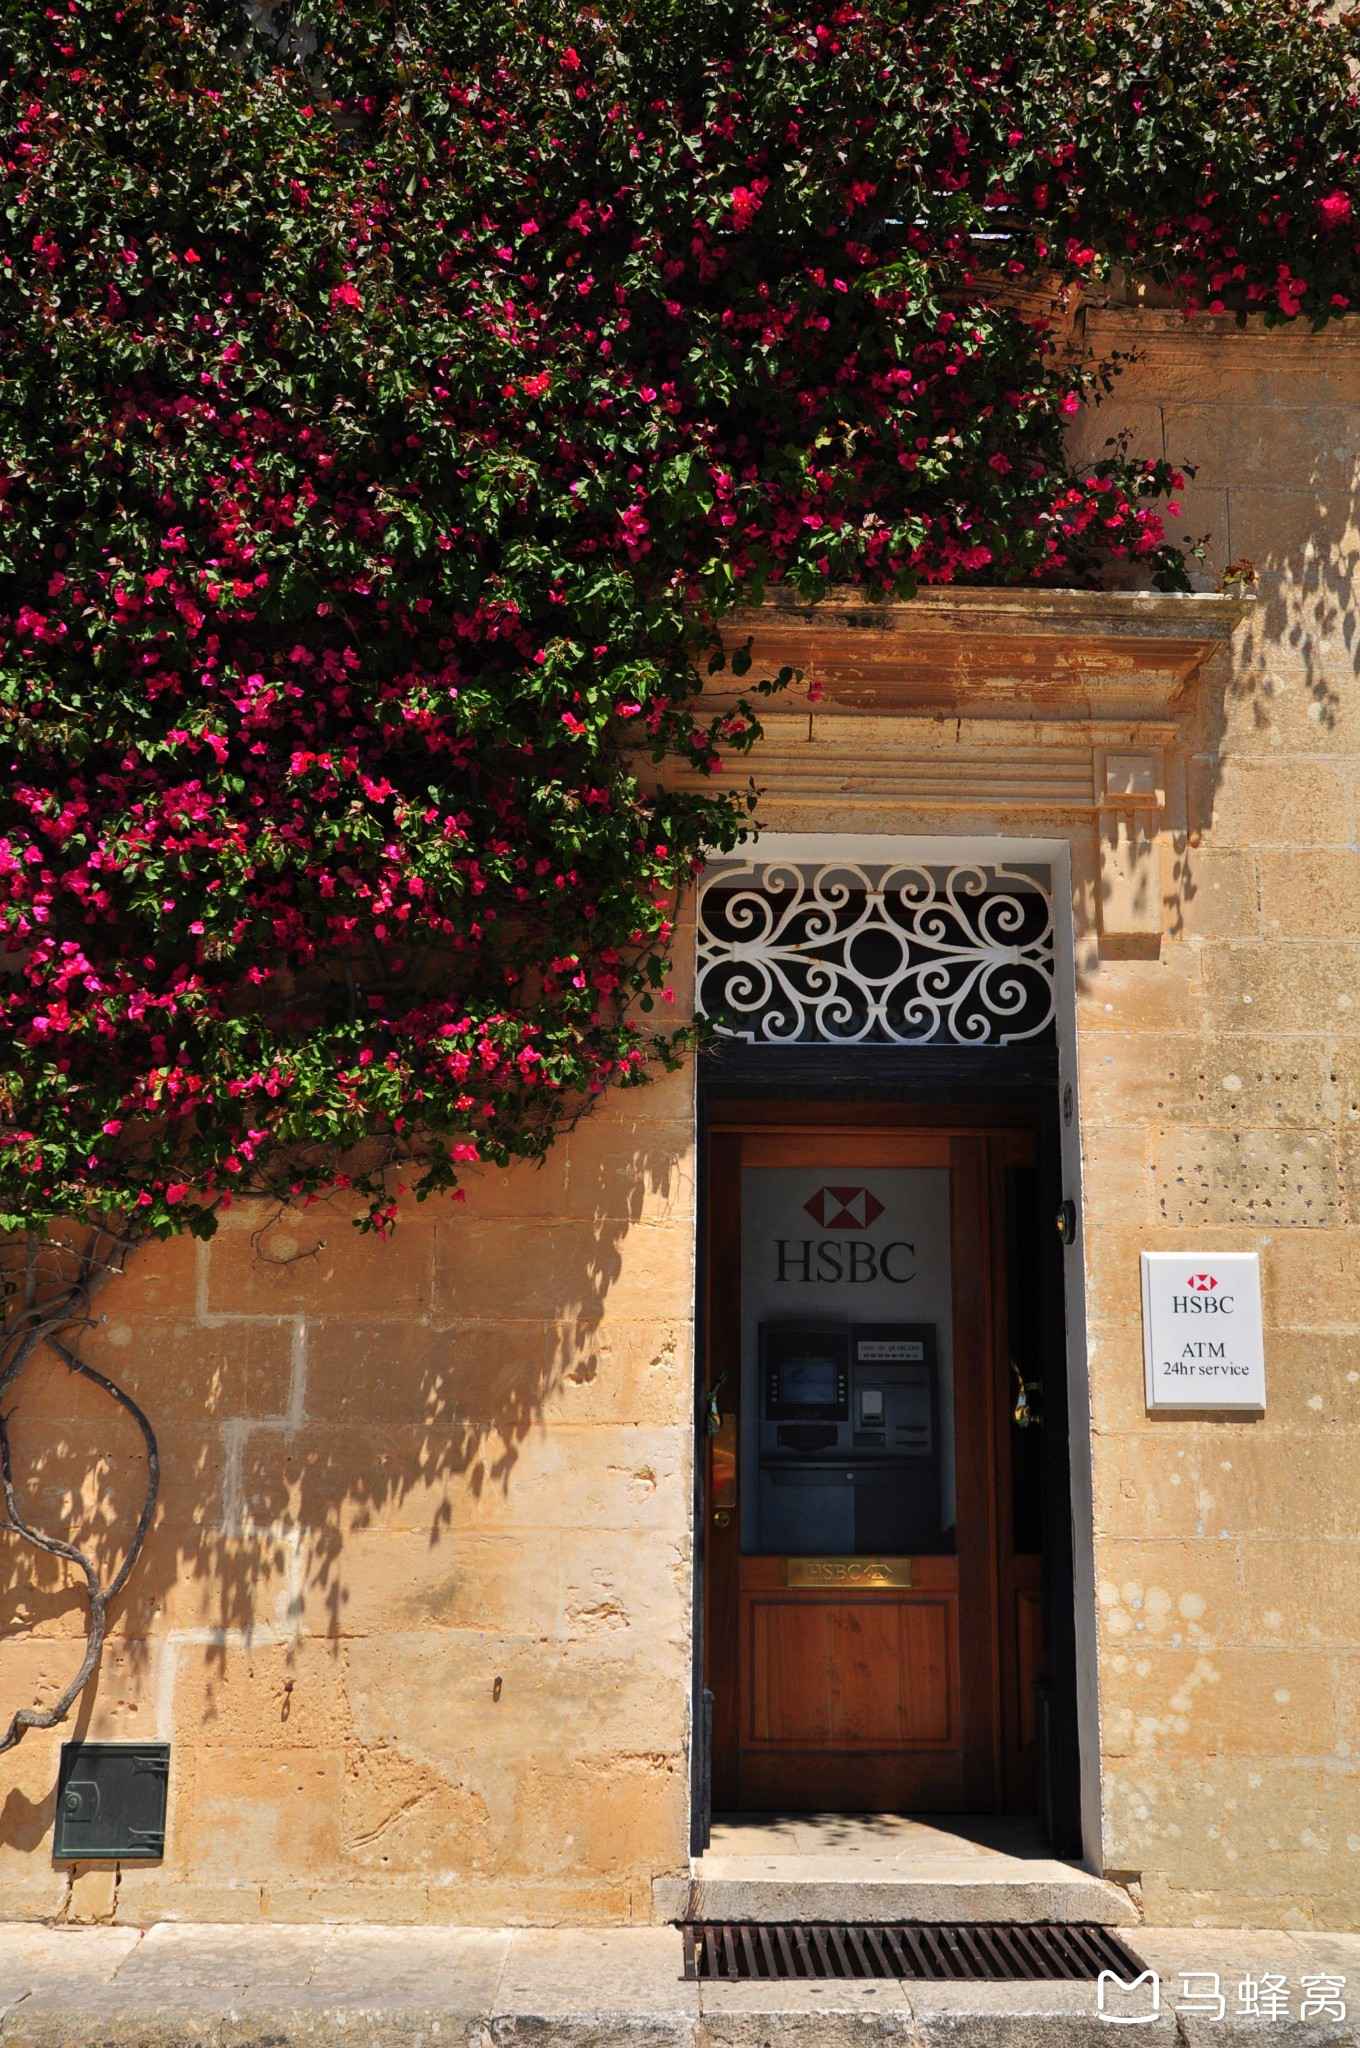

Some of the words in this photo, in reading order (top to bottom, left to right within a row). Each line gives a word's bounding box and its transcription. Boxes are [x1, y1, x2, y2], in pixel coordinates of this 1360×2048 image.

[772, 1239, 919, 1284] HSBC
[1172, 1296, 1234, 1314] HSBC
[1181, 1342, 1226, 1358] ATM
[1163, 1362, 1195, 1376] 24hr
[1198, 1362, 1250, 1376] service
[807, 1563, 862, 1580] HSBC
